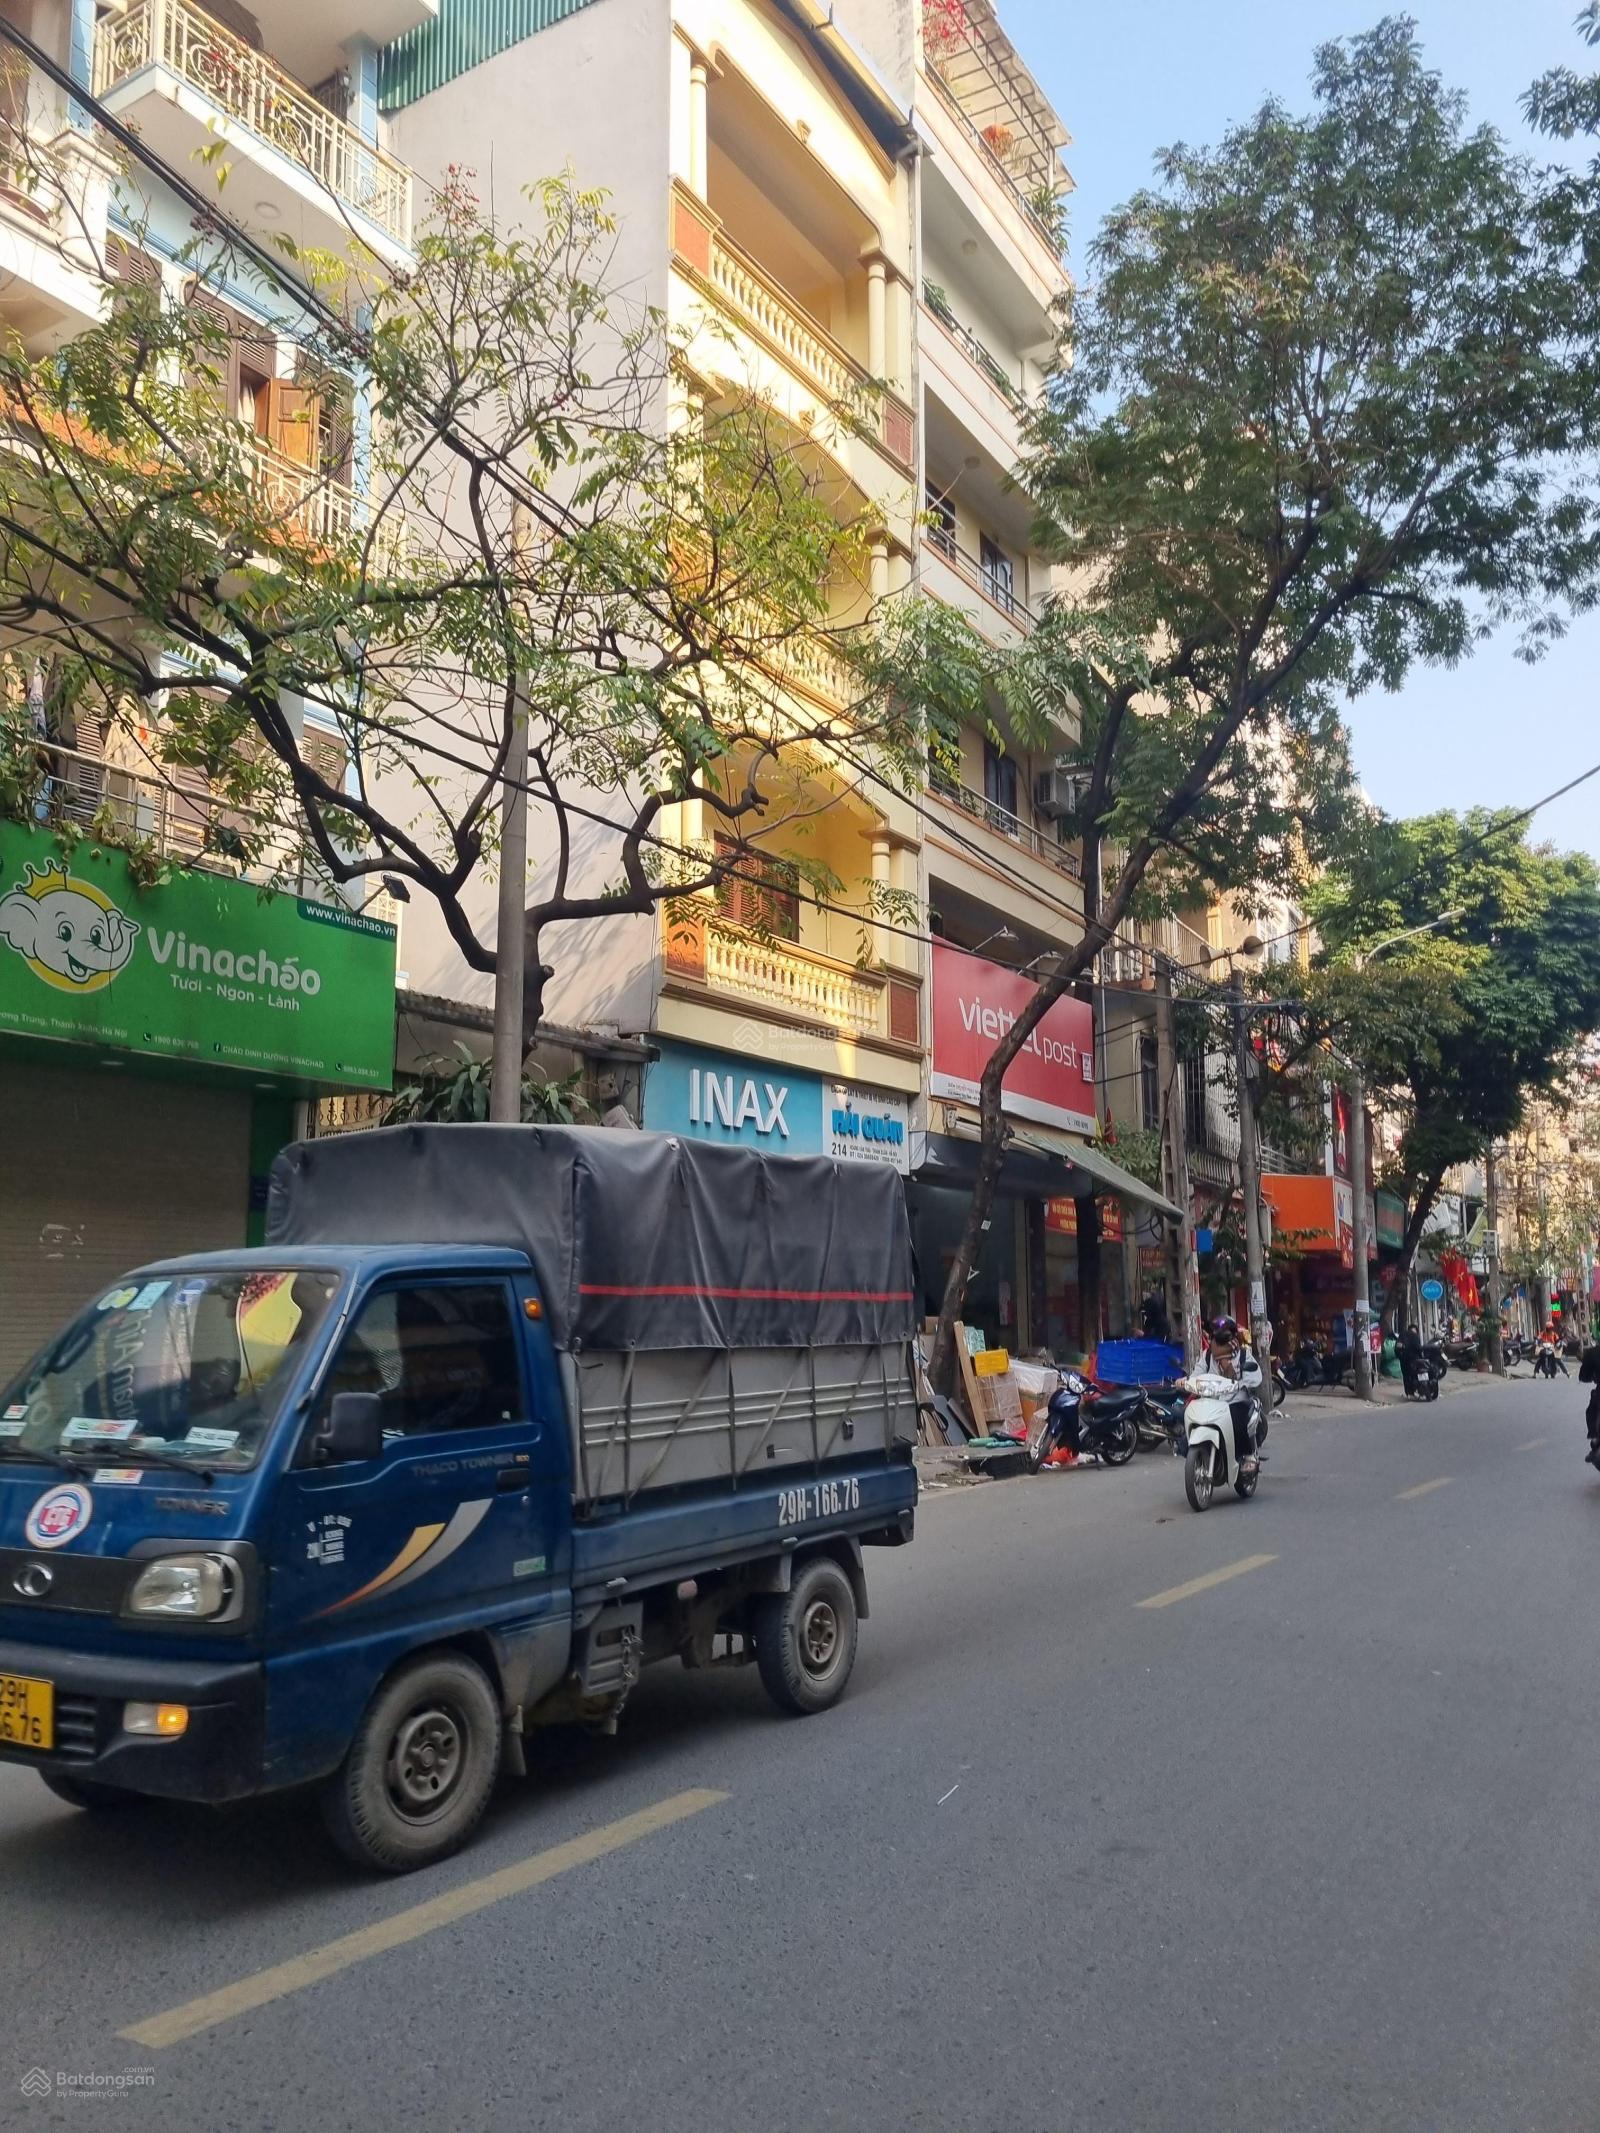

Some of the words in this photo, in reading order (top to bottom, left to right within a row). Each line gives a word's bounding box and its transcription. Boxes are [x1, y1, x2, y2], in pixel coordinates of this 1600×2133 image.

[306, 905, 396, 937] www.vinachao.vn
[216, 984, 255, 1004] Ngon
[268, 993, 300, 1011] Lành
[1042, 1036, 1078, 1070] post
[689, 1068, 790, 1136] INAX
[832, 1142, 847, 1156] 214
[411, 1460, 459, 1477] THACO
[460, 1452, 515, 1470] TOWNER
[778, 1477, 860, 1527] 29H-166.76
